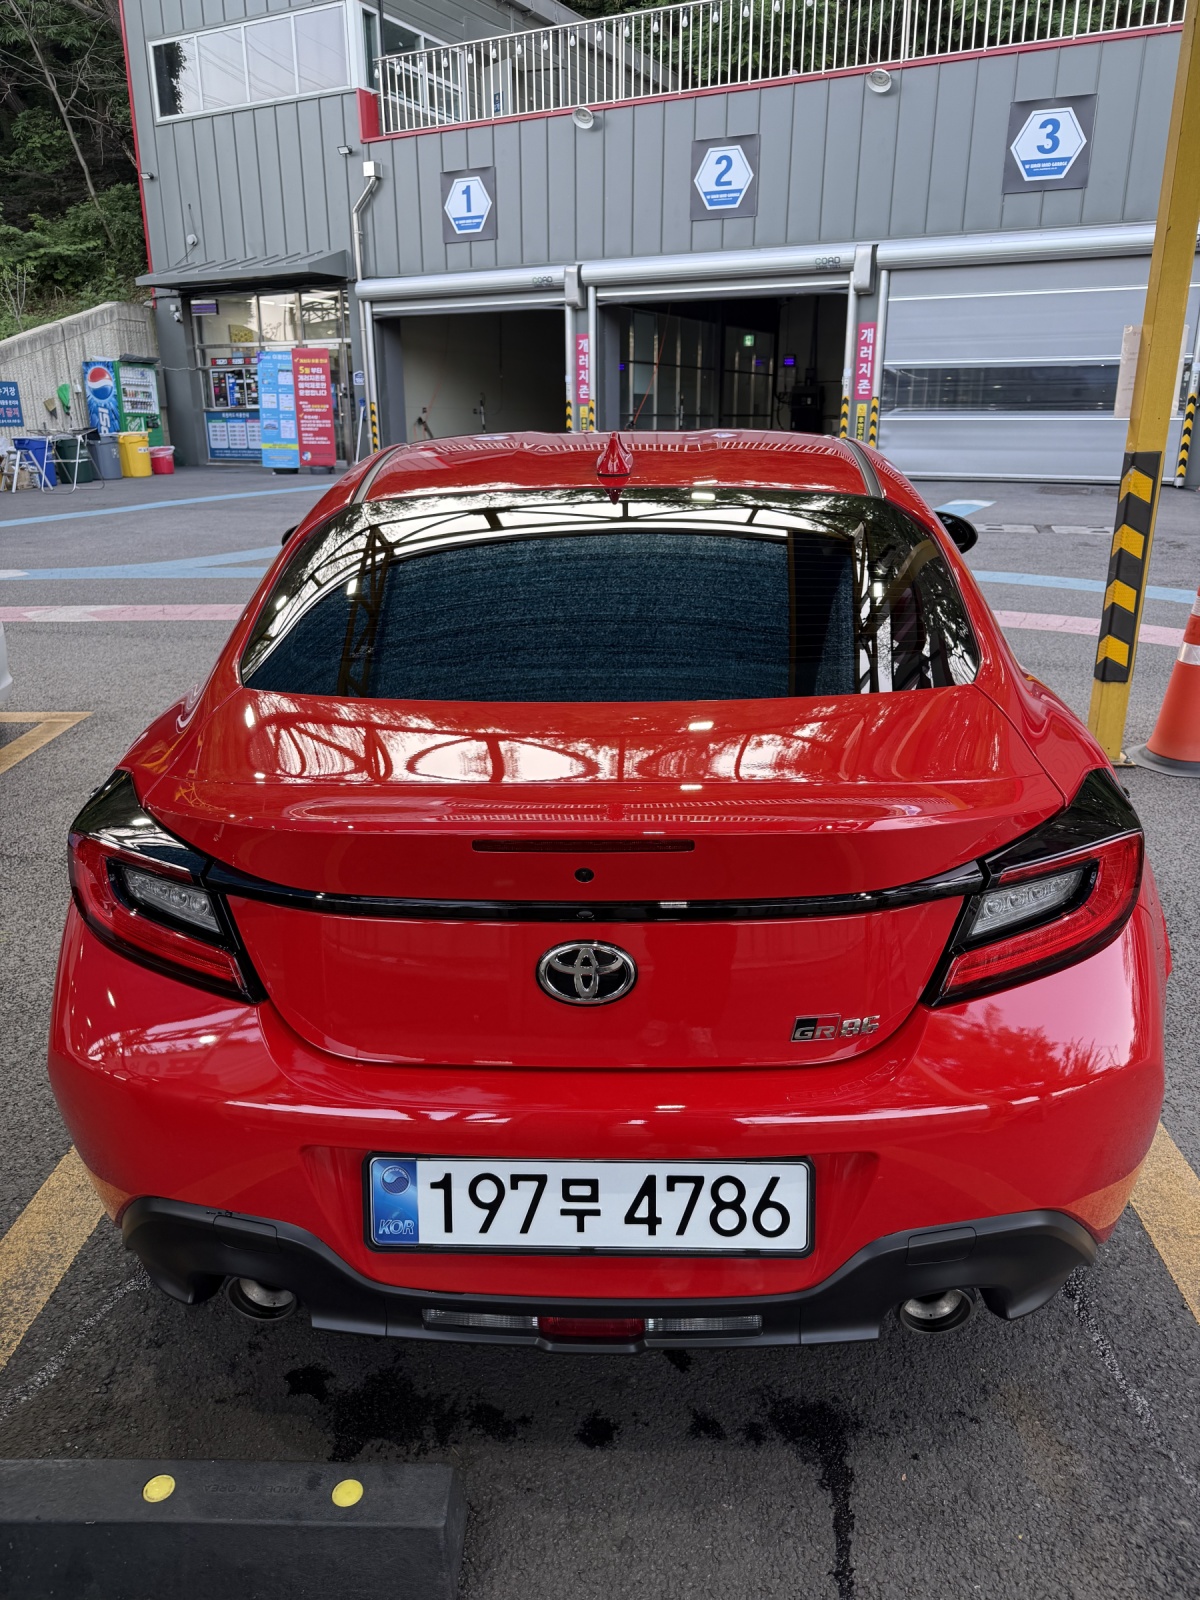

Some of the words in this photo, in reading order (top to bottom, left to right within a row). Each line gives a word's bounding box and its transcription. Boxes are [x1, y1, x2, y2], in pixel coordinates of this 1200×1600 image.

[1036, 118, 1061, 155] 3
[715, 155, 733, 187] 2
[461, 185, 472, 213] 1
[578, 339, 590, 399] 개러지존
[857, 328, 875, 395] 개러지존
[794, 1026, 835, 1040] GR
[840, 1015, 881, 1036] 86
[430, 1172, 601, 1234] 197무
[624, 1174, 791, 1238] 4786
[378, 1219, 415, 1235] KOR
[203, 1483, 240, 1493] OREA
